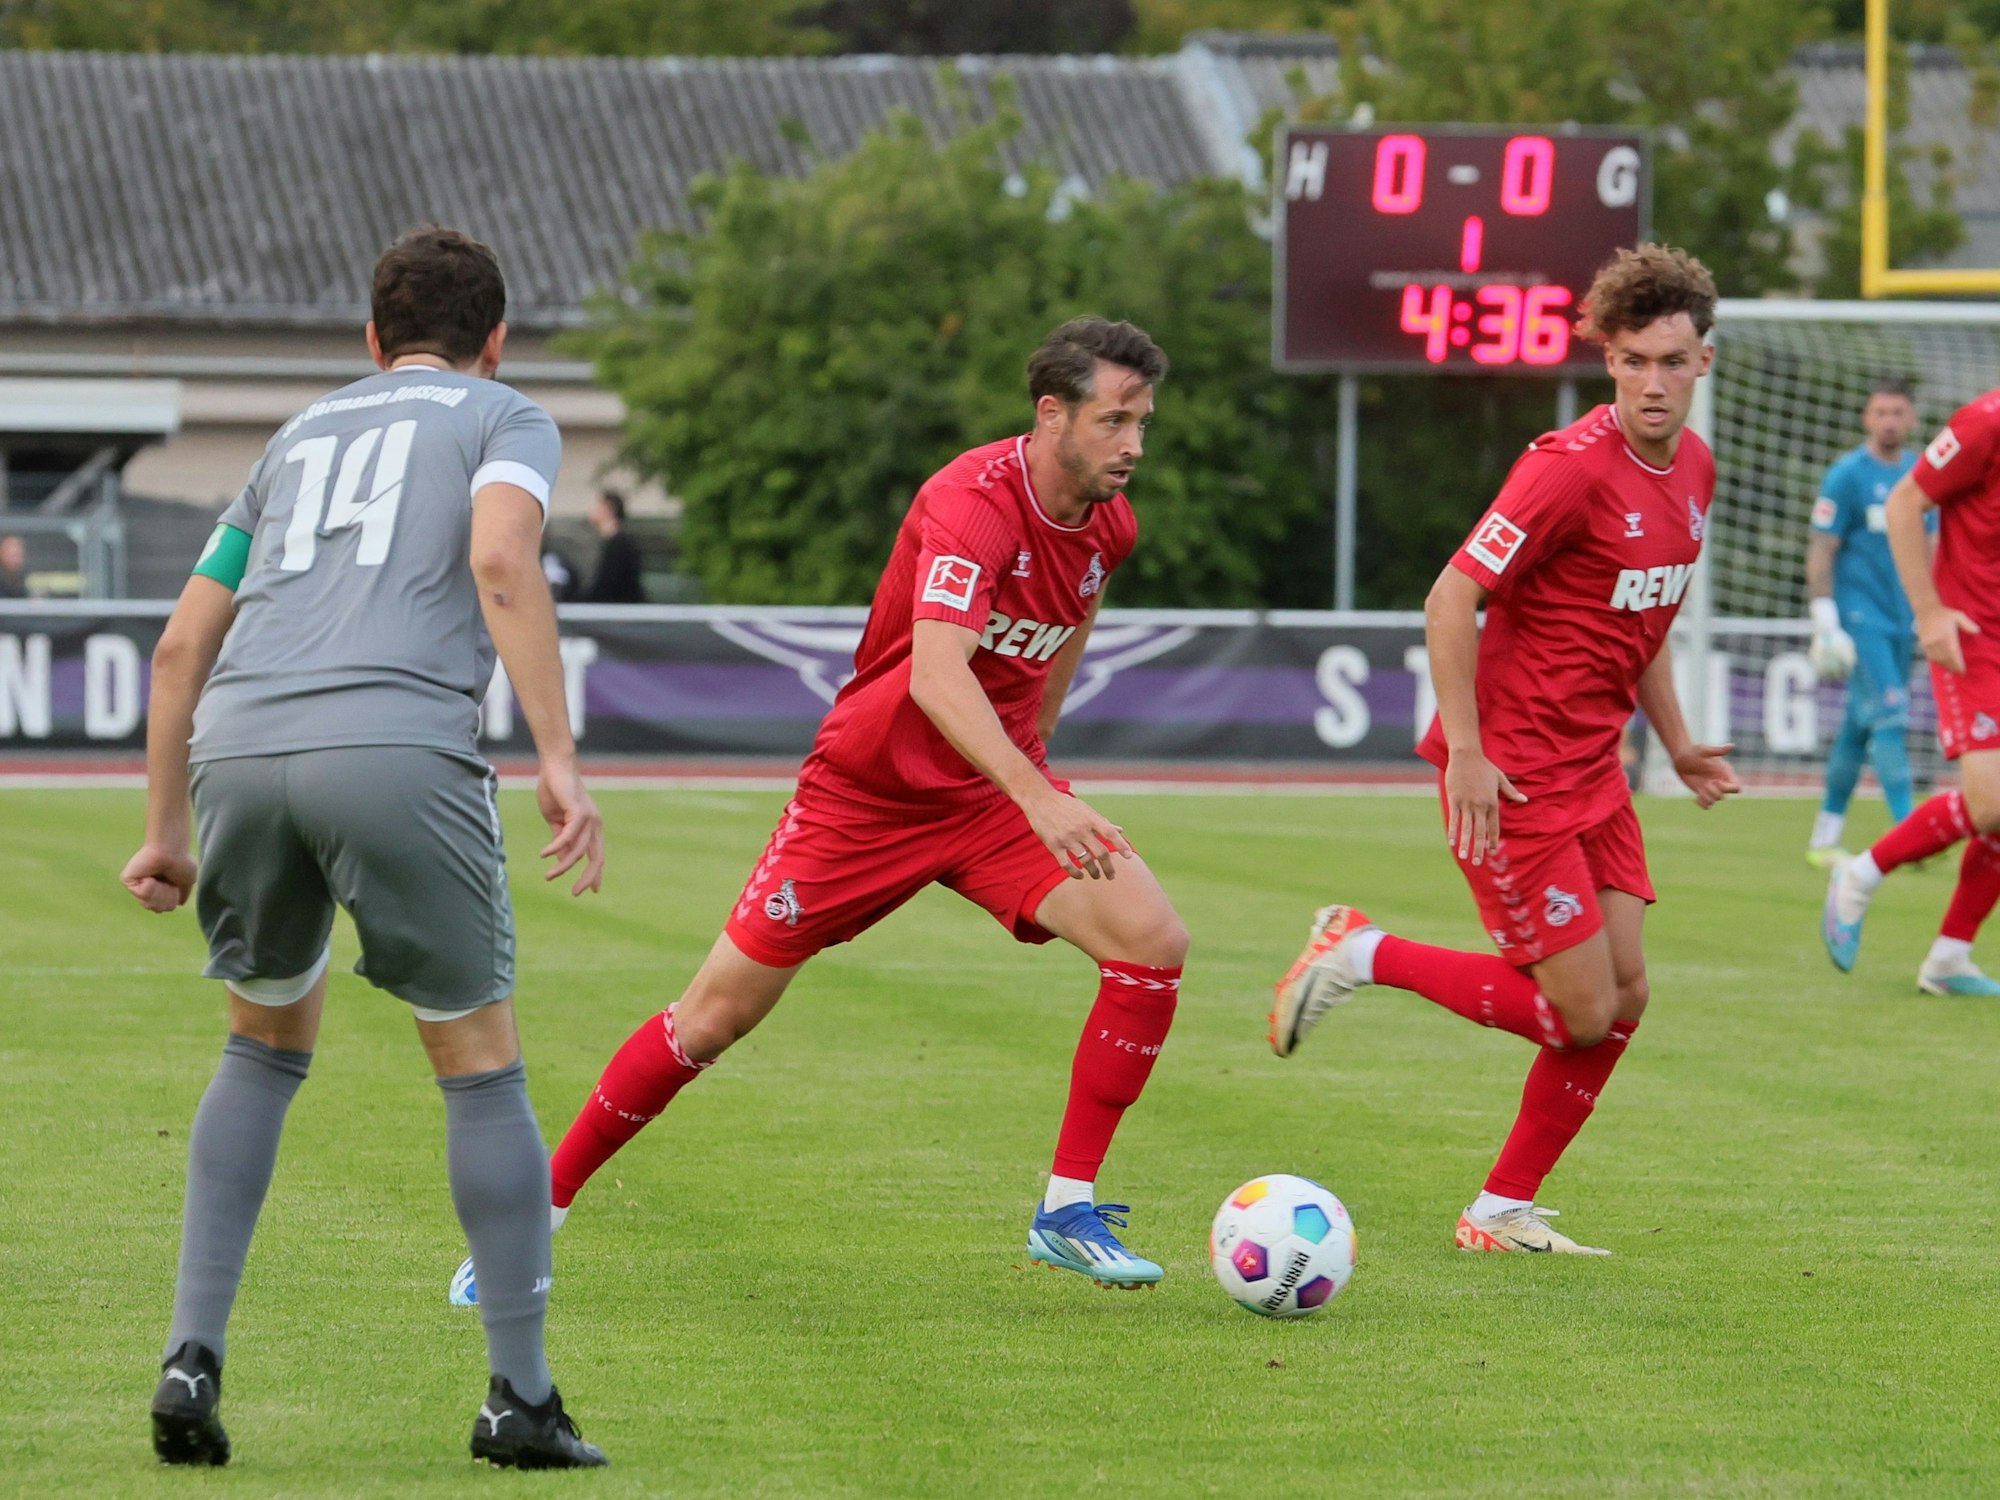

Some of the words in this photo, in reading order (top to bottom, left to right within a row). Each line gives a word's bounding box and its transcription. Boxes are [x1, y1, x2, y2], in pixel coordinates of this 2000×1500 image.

[1285, 141, 1328, 201] H
[1372, 134, 1426, 214] 0
[1501, 135, 1554, 216] 0
[1597, 146, 1641, 208] G
[1460, 215, 1484, 273] 1
[1401, 284, 1573, 364] 4:36
[279, 420, 417, 571] 14
[1115, 1038, 1137, 1053] FC
